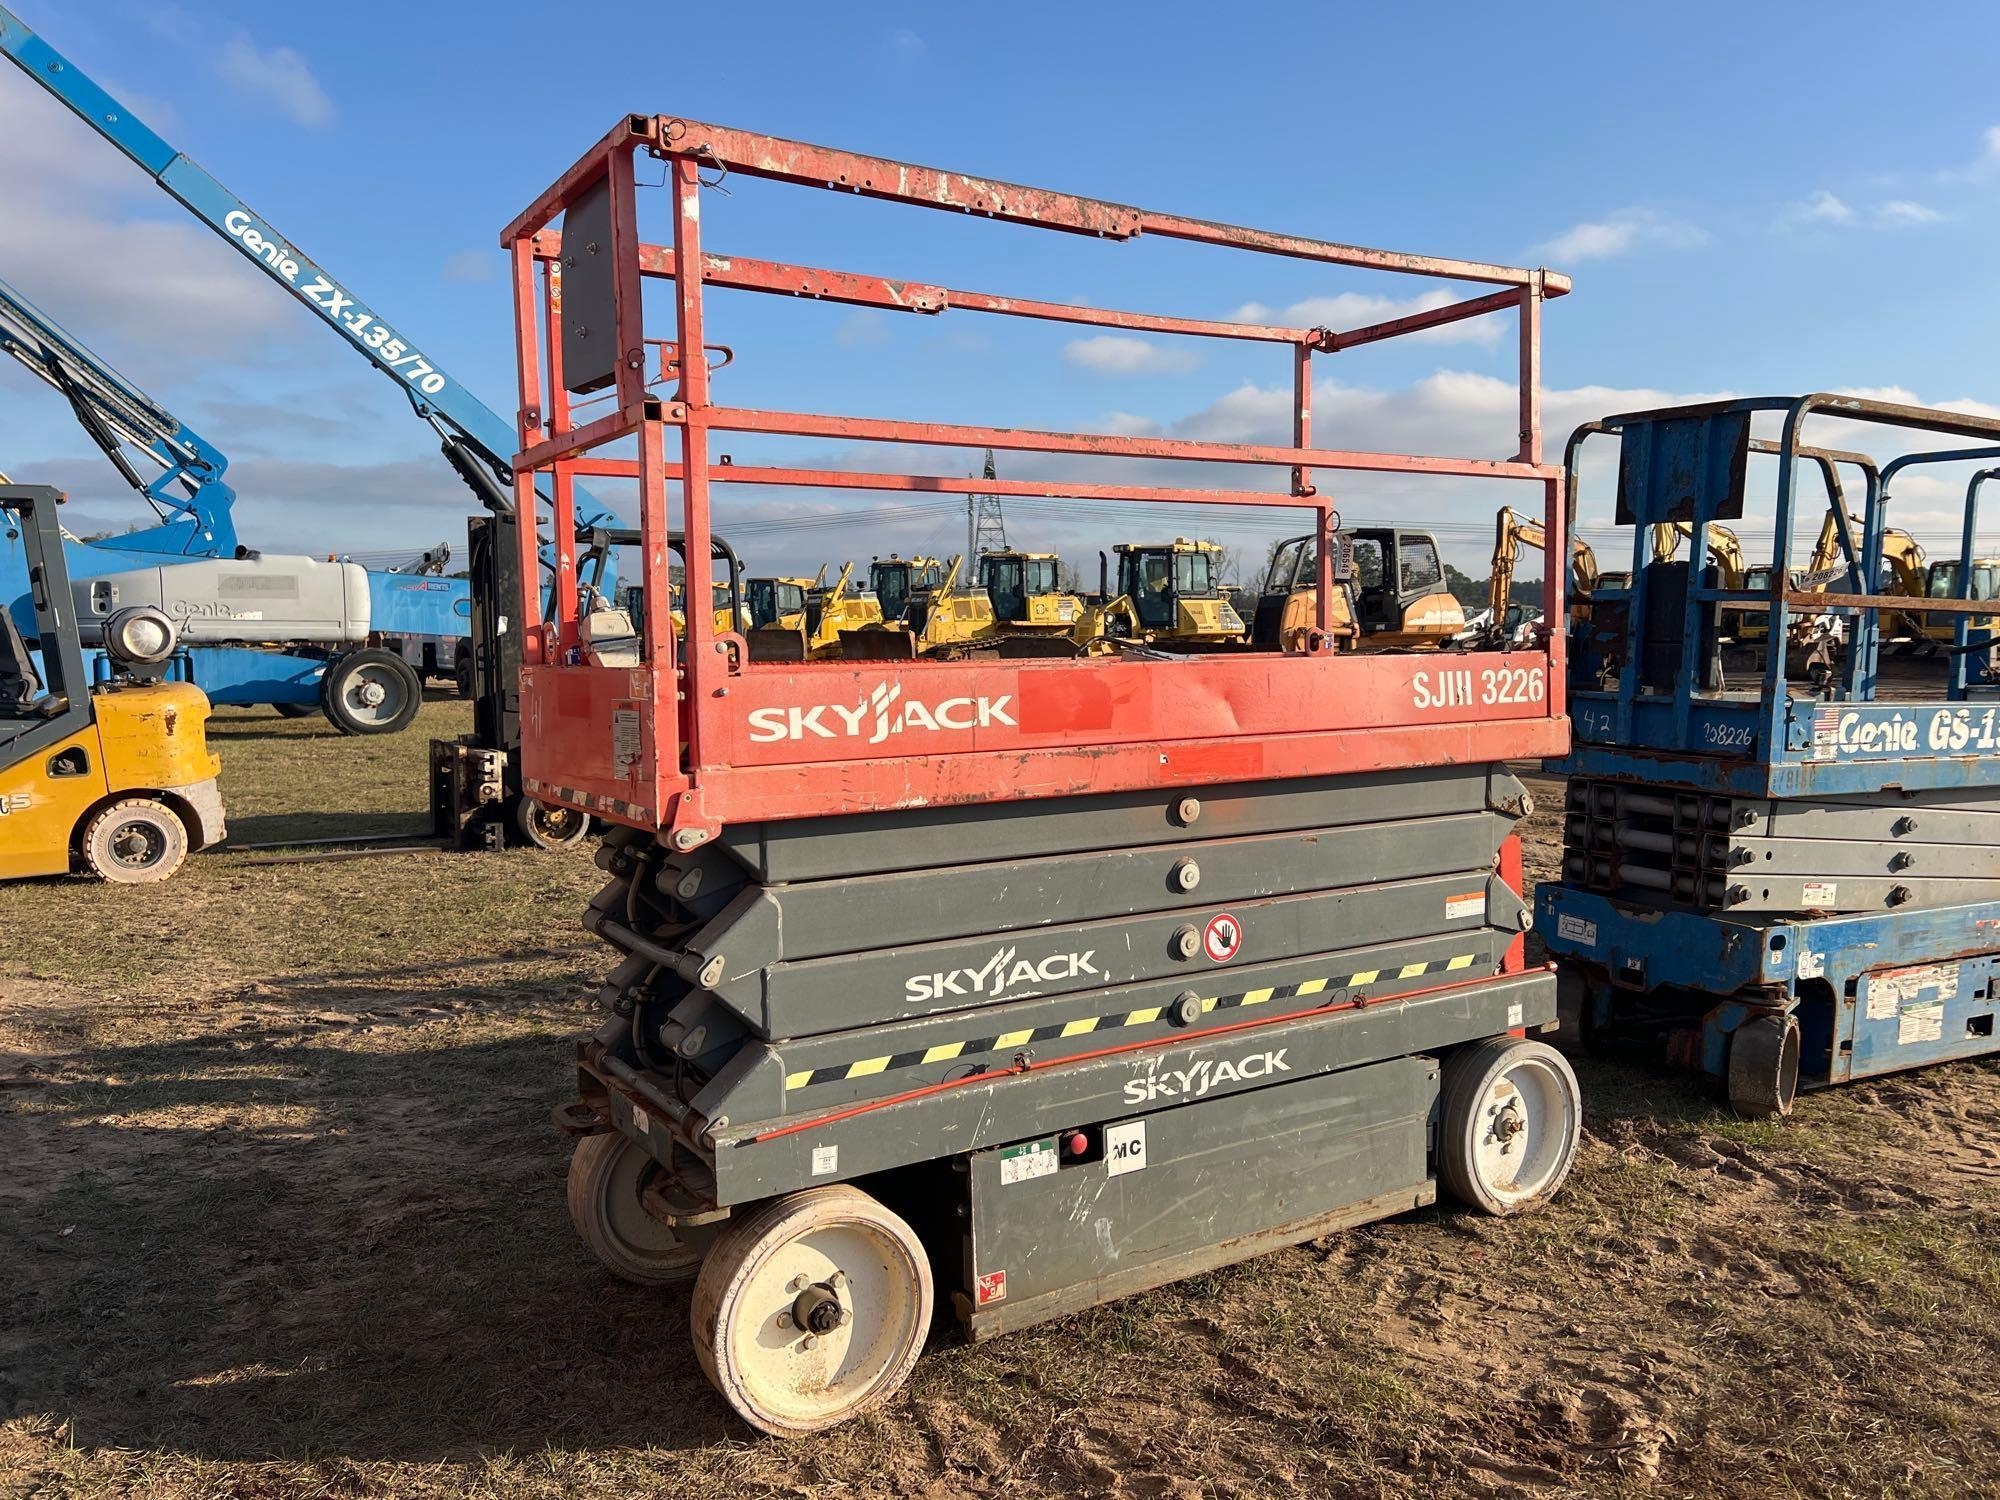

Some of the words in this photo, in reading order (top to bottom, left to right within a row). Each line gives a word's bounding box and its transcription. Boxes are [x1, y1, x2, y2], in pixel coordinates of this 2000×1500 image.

[224, 210, 299, 283] Genie
[300, 275, 445, 394] ZX-135/70
[1341, 543, 1351, 574] 206548
[1481, 667, 1544, 705] 3226
[747, 679, 1019, 745] SKYJACK
[1838, 711, 1920, 754] Genie
[1928, 708, 2000, 751] GS-1
[904, 945, 1100, 1002] SKYJACK
[1123, 1048, 1292, 1105] SKYJACK
[1112, 1139, 1142, 1160] MC
